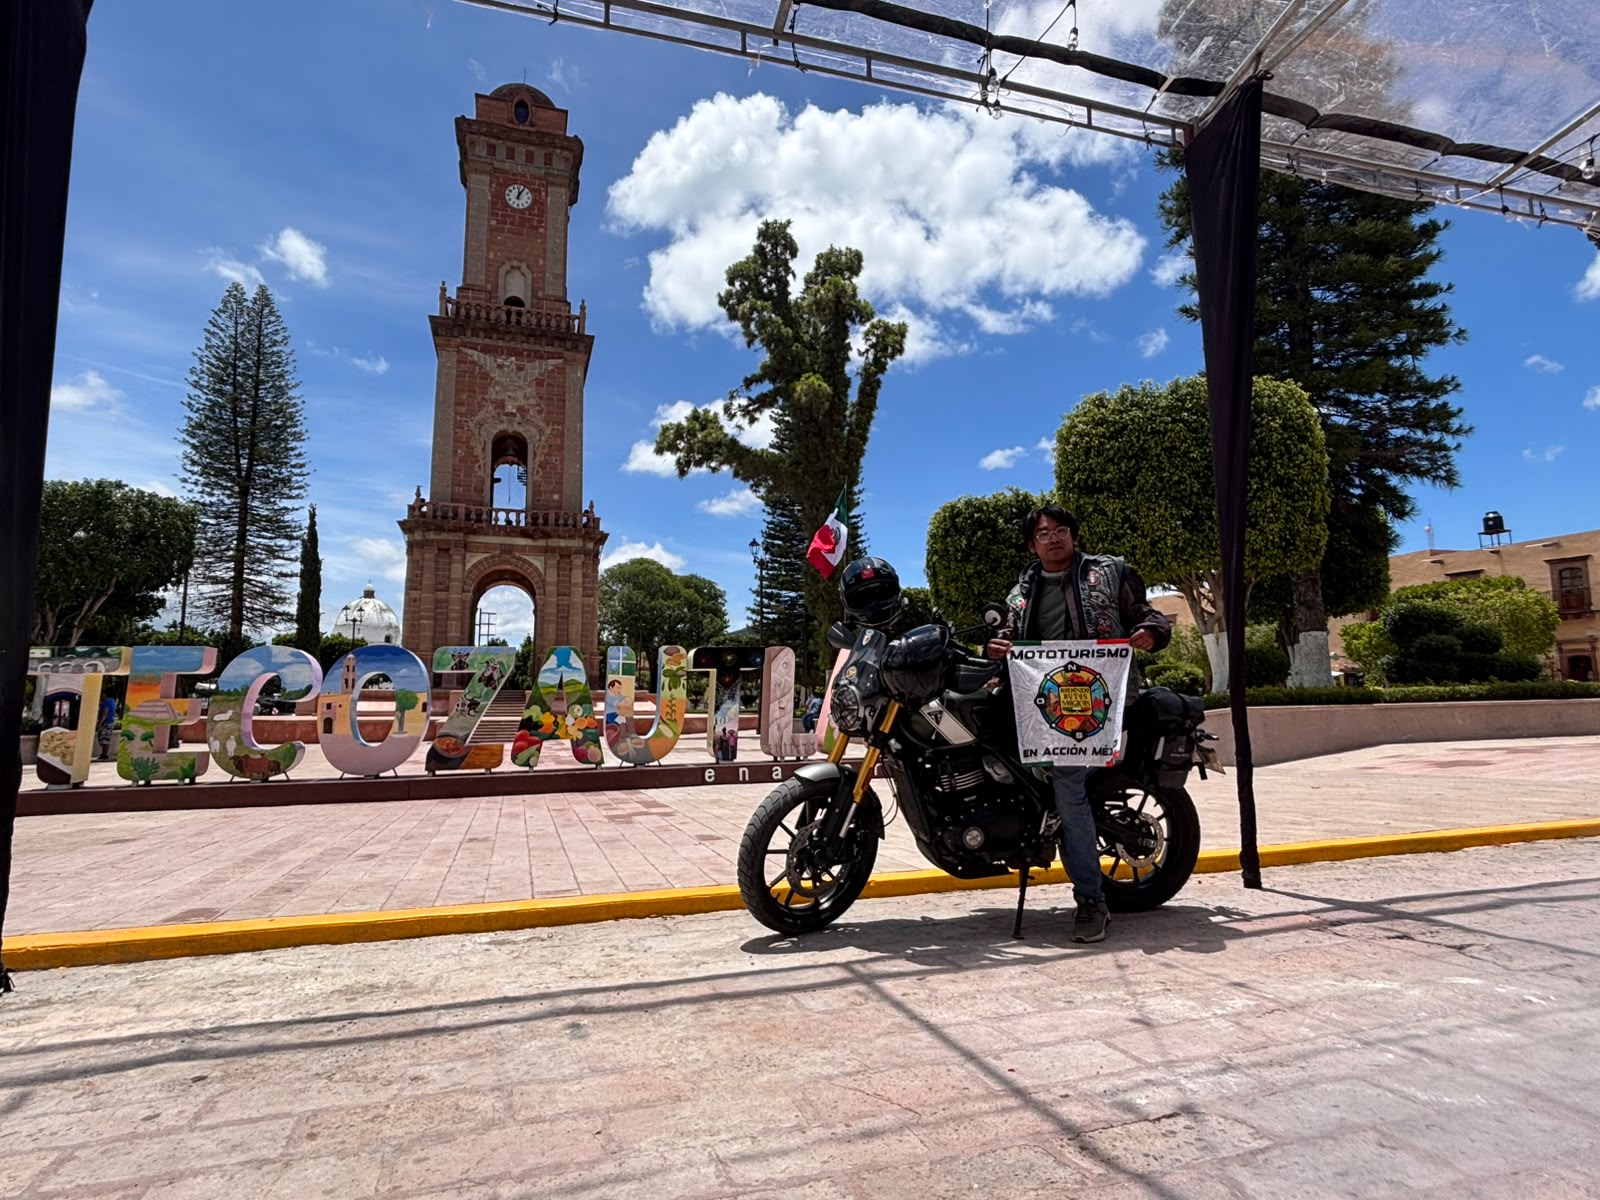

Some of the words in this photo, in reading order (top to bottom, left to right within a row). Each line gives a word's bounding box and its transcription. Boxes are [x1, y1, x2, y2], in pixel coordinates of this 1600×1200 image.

[1010, 648, 1129, 660] MOTOTURISMO
[1023, 748, 1038, 758] EN
[1042, 744, 1087, 756] ACCIÓN
